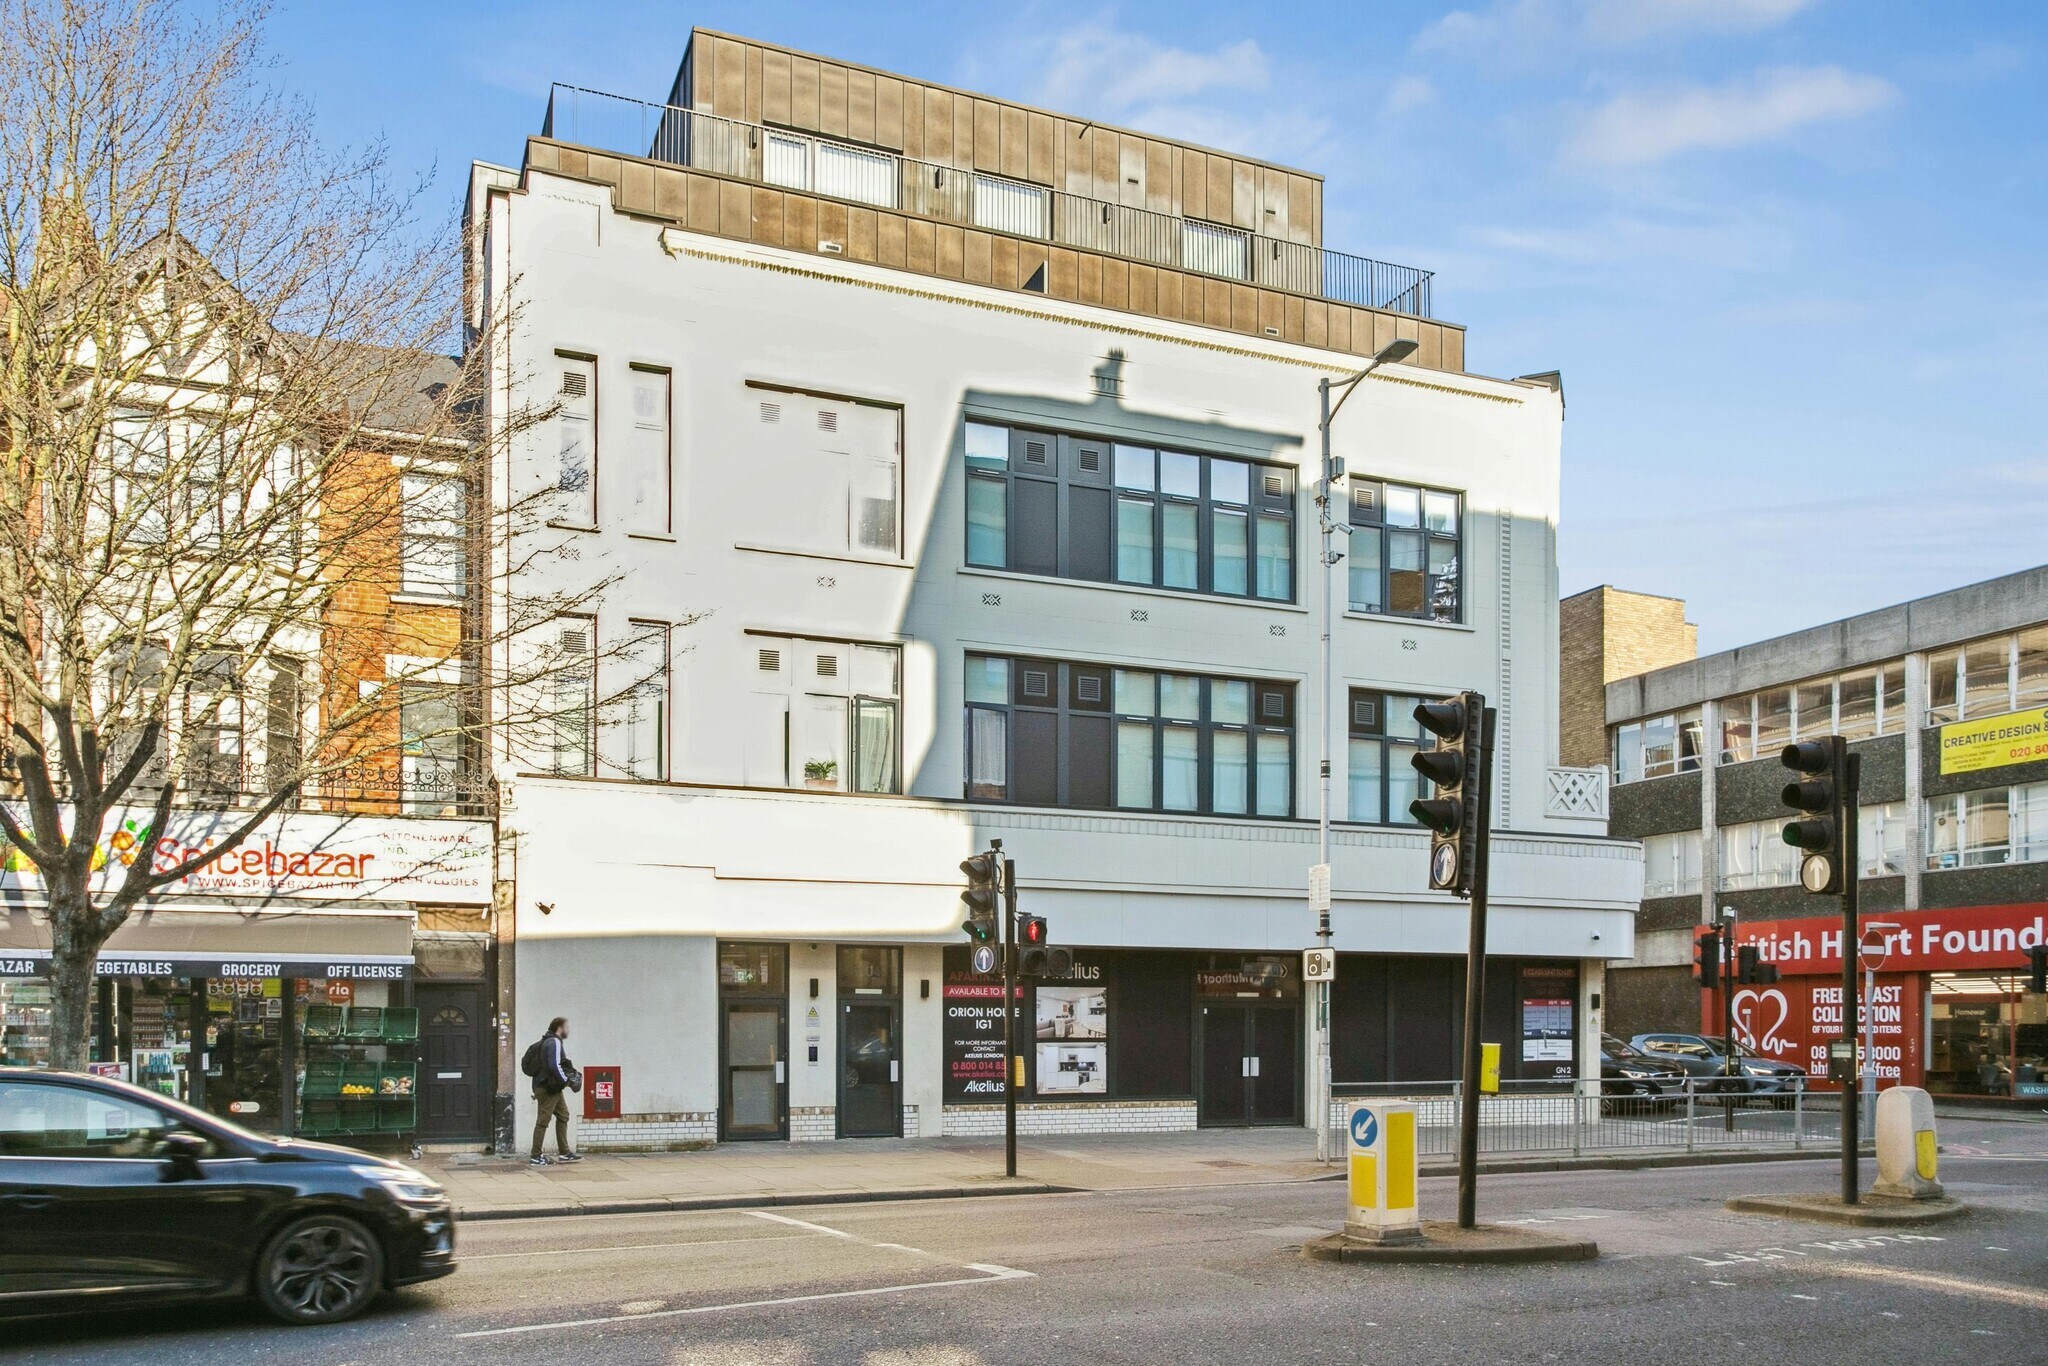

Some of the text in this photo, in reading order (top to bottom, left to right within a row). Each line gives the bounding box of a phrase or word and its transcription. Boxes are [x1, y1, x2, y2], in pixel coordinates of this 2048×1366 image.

[1943, 730, 1996, 749] CREATIVE
[1998, 723, 2041, 739] DESIGN
[2010, 746, 2031, 758] 020
[154, 837, 375, 884] Spicebazar
[1923, 916, 2048, 955] Found
[222, 963, 281, 977] GROCERY
[329, 982, 350, 995] ria
[949, 987, 988, 996] AVAILABLE
[989, 987, 1000, 996] TO
[949, 1007, 984, 1018] ORION
[975, 1019, 992, 1030] IG1
[1812, 1025, 1820, 1034] OF
[1821, 1025, 1840, 1034] YOUR
[1879, 1025, 1902, 1034] ITEMS
[960, 1062, 977, 1070] 800
[978, 1062, 993, 1070] 014
[1555, 1066, 1567, 1074] GN
[963, 1080, 1005, 1093] Akelius
